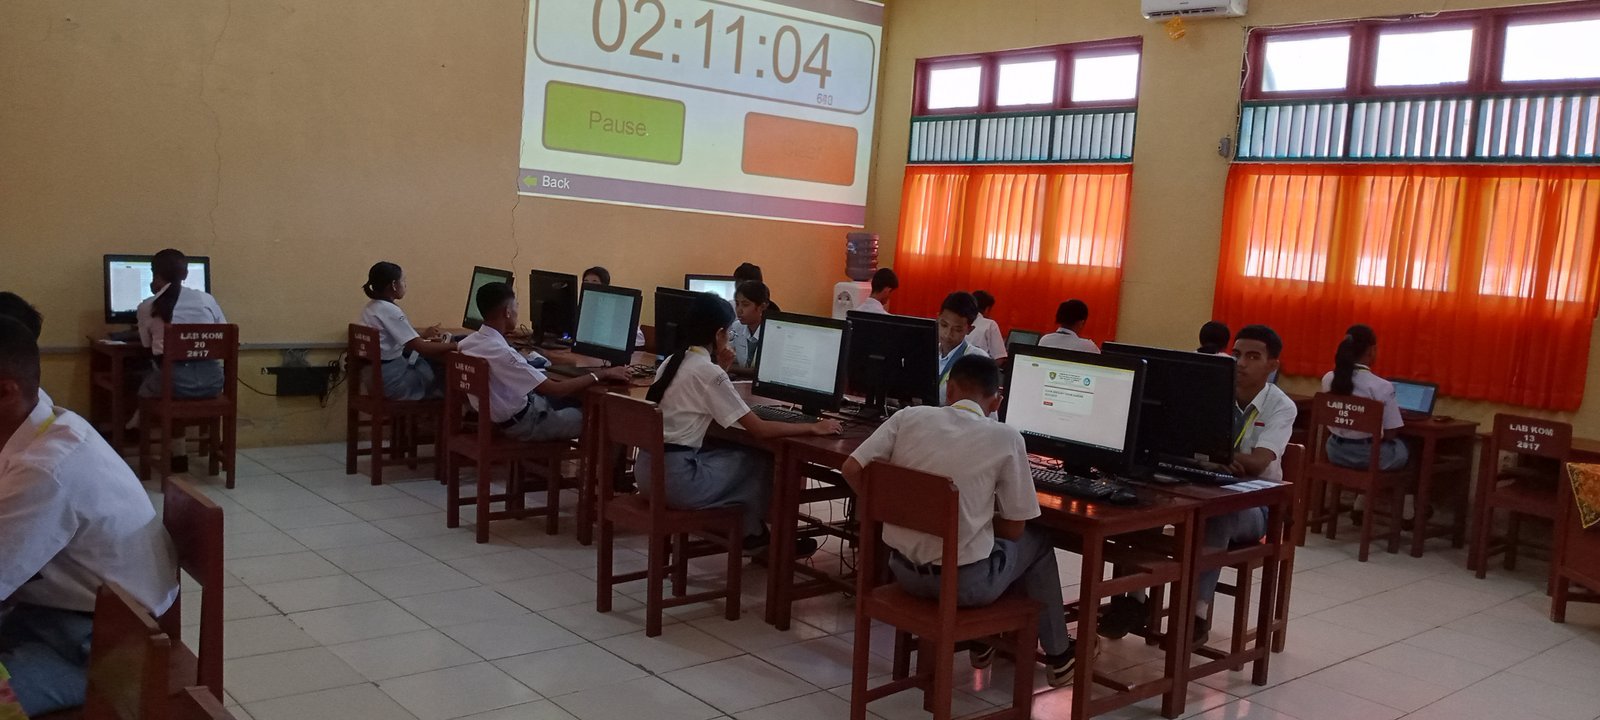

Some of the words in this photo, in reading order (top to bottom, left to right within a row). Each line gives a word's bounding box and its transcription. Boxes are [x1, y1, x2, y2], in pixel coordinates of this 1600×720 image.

[592, 0, 832, 89] 02:11:04
[588, 111, 647, 136] Pause
[542, 176, 570, 190] Back
[180, 332, 199, 340] LAB
[201, 332, 224, 340] KOM
[1327, 401, 1343, 409] LAB
[1345, 404, 1365, 413] KOM
[1334, 416, 1354, 426] 2017
[1509, 424, 1529, 432] LAB
[1530, 426, 1553, 436] KOM
[1516, 440, 1540, 451] 2017
